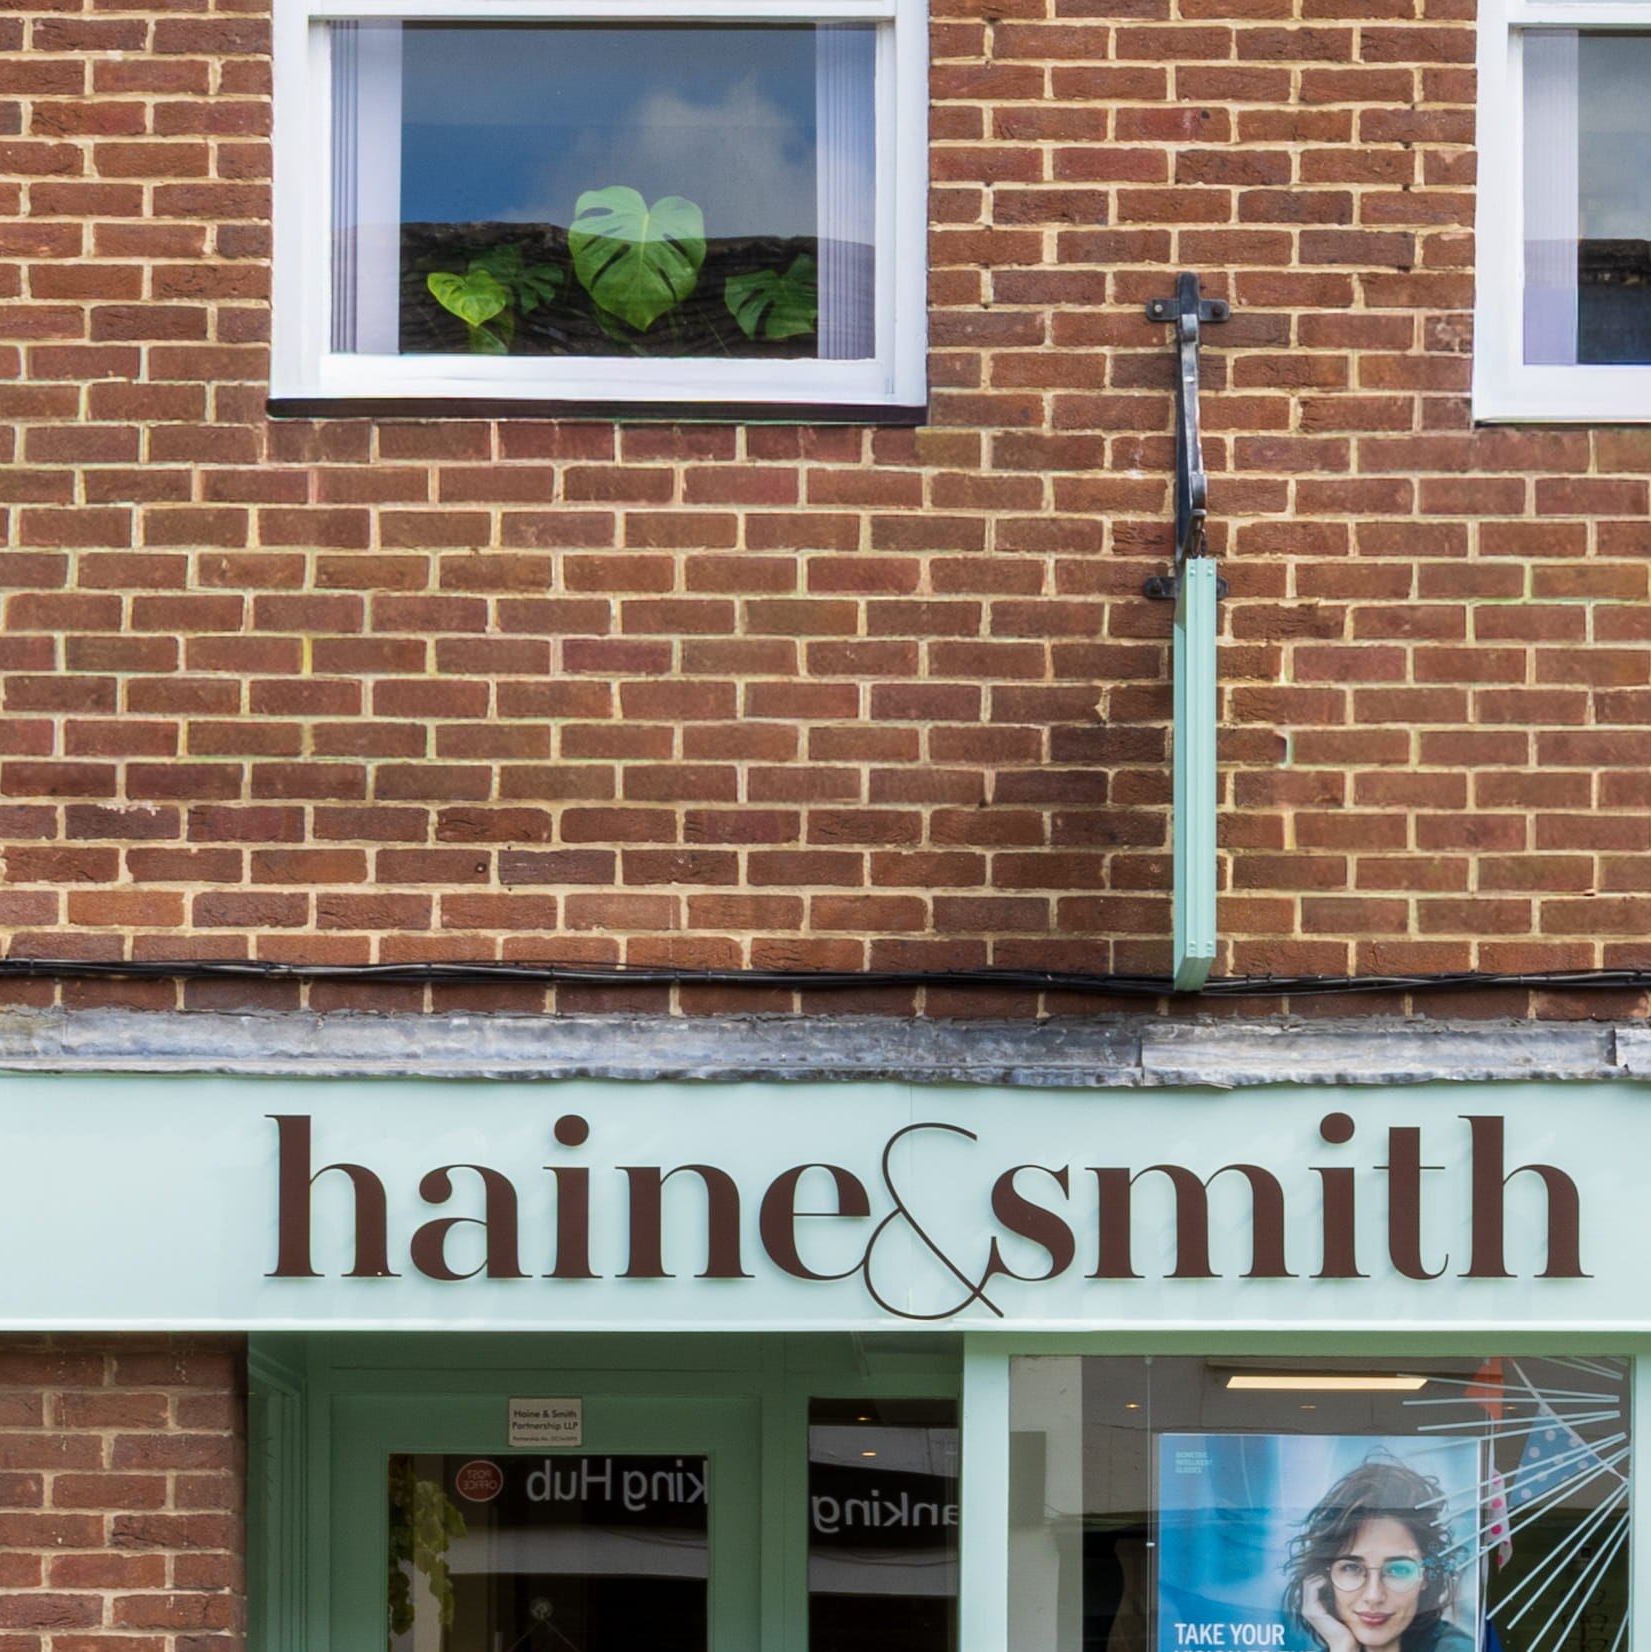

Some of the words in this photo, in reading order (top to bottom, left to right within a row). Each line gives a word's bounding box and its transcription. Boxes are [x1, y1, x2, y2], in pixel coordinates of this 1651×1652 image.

[263, 1114, 1595, 1321] haine&smith
[514, 1409, 541, 1419] Haine
[542, 1409, 550, 1418] &
[551, 1409, 577, 1419] Smith
[512, 1421, 561, 1431] Partnership
[564, 1421, 579, 1430] LLP
[1174, 1623, 1225, 1645] TAKE
[1229, 1623, 1285, 1646] YOUR
